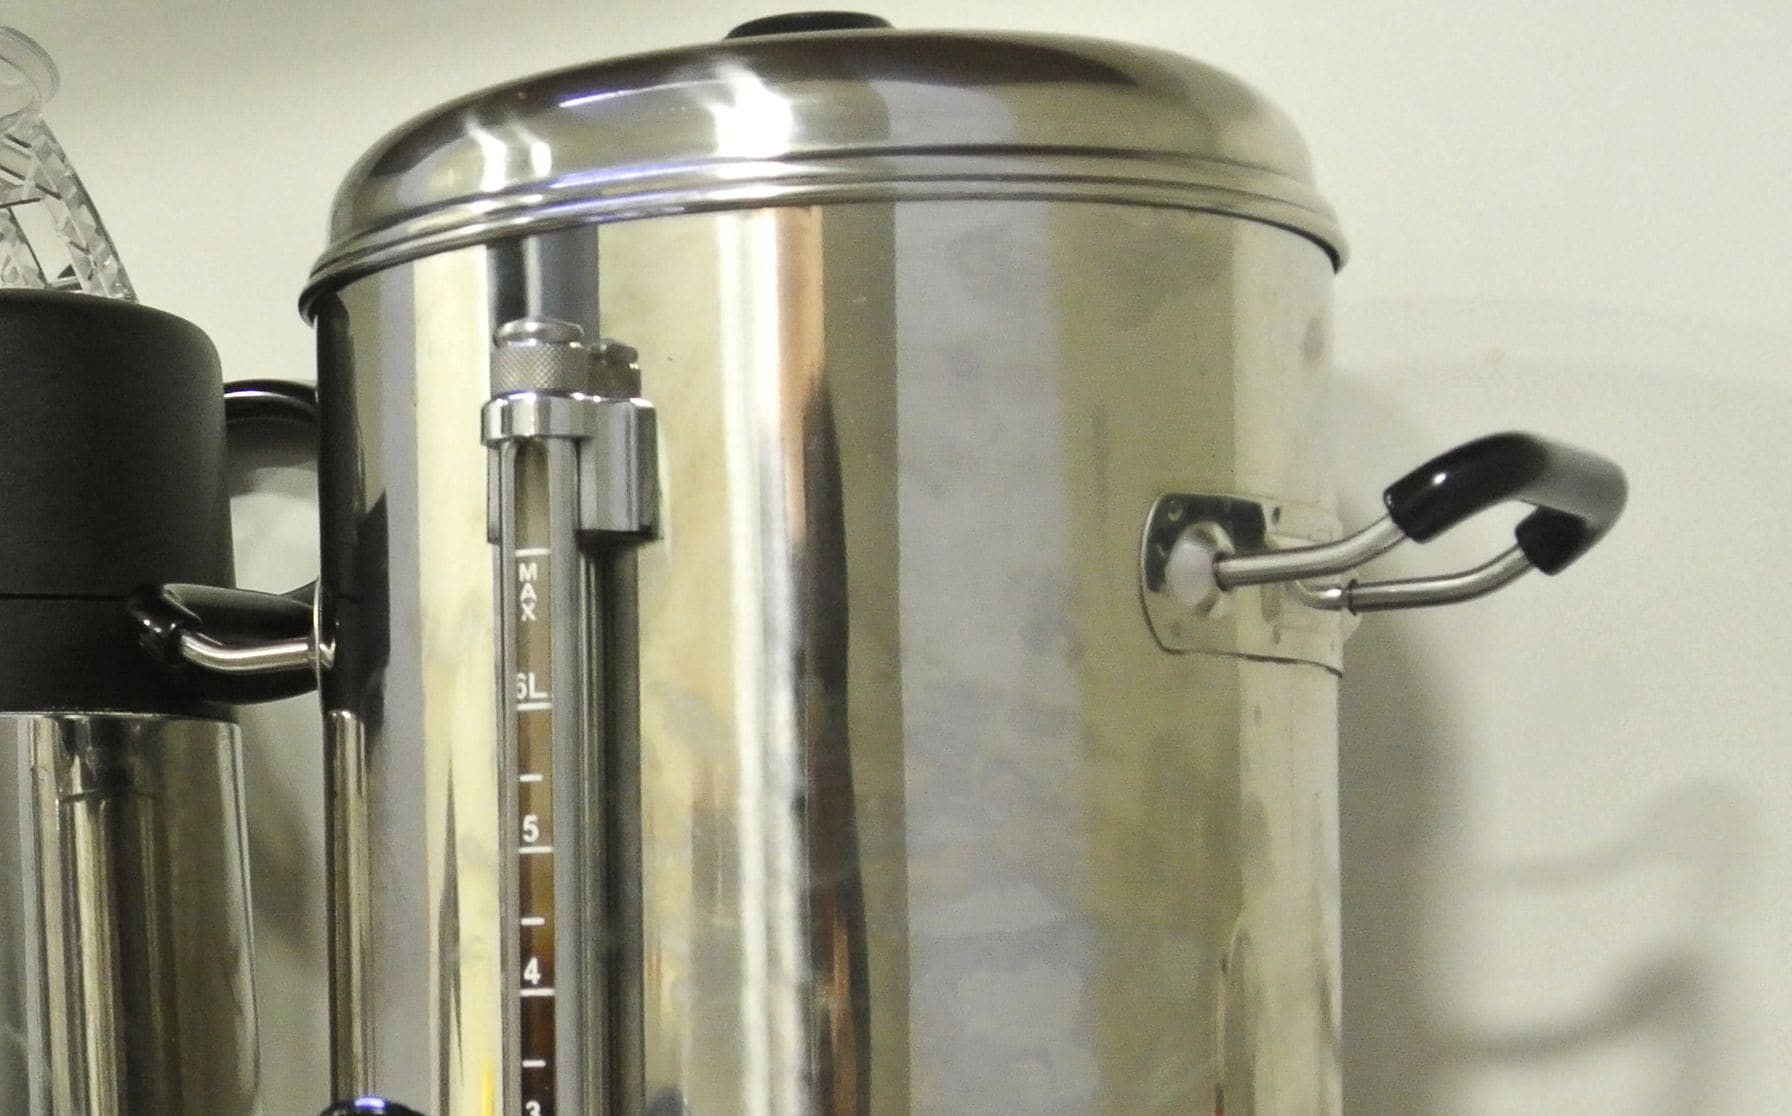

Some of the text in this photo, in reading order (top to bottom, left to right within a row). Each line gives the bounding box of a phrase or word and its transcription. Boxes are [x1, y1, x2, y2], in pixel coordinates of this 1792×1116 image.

[518, 563, 538, 621] MAX
[522, 815, 540, 842] 5
[523, 956, 541, 984] 4
